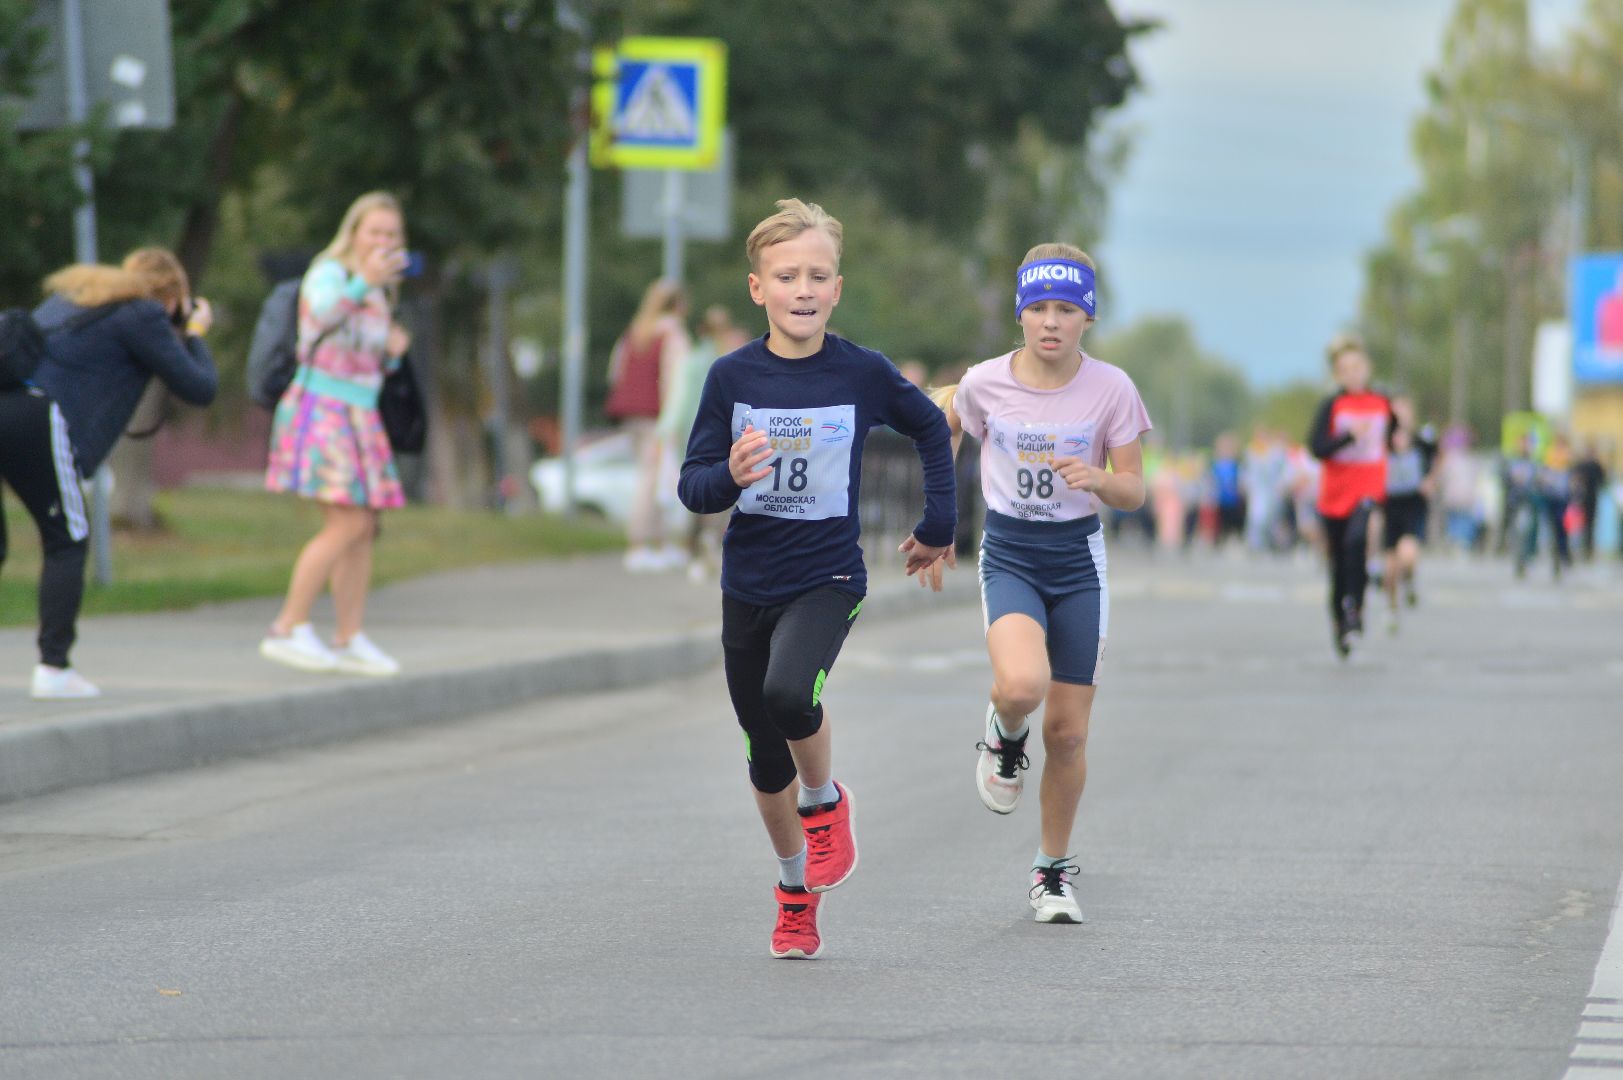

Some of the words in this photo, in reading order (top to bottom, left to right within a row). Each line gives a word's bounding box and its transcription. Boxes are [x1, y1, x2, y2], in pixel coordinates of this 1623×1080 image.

[1021, 264, 1082, 287] LUKOIL
[770, 417, 801, 427] КРОСС
[770, 428, 811, 439] НАЦИИ
[1017, 432, 1046, 442] КРОСС
[770, 438, 811, 451] 2023
[1017, 442, 1055, 452] НАЦИИ
[768, 457, 808, 492] 18
[1017, 468, 1054, 499] 98
[755, 494, 816, 504] МОСКОВСКАЯ
[764, 504, 805, 514] ОБЛАСТЬ
